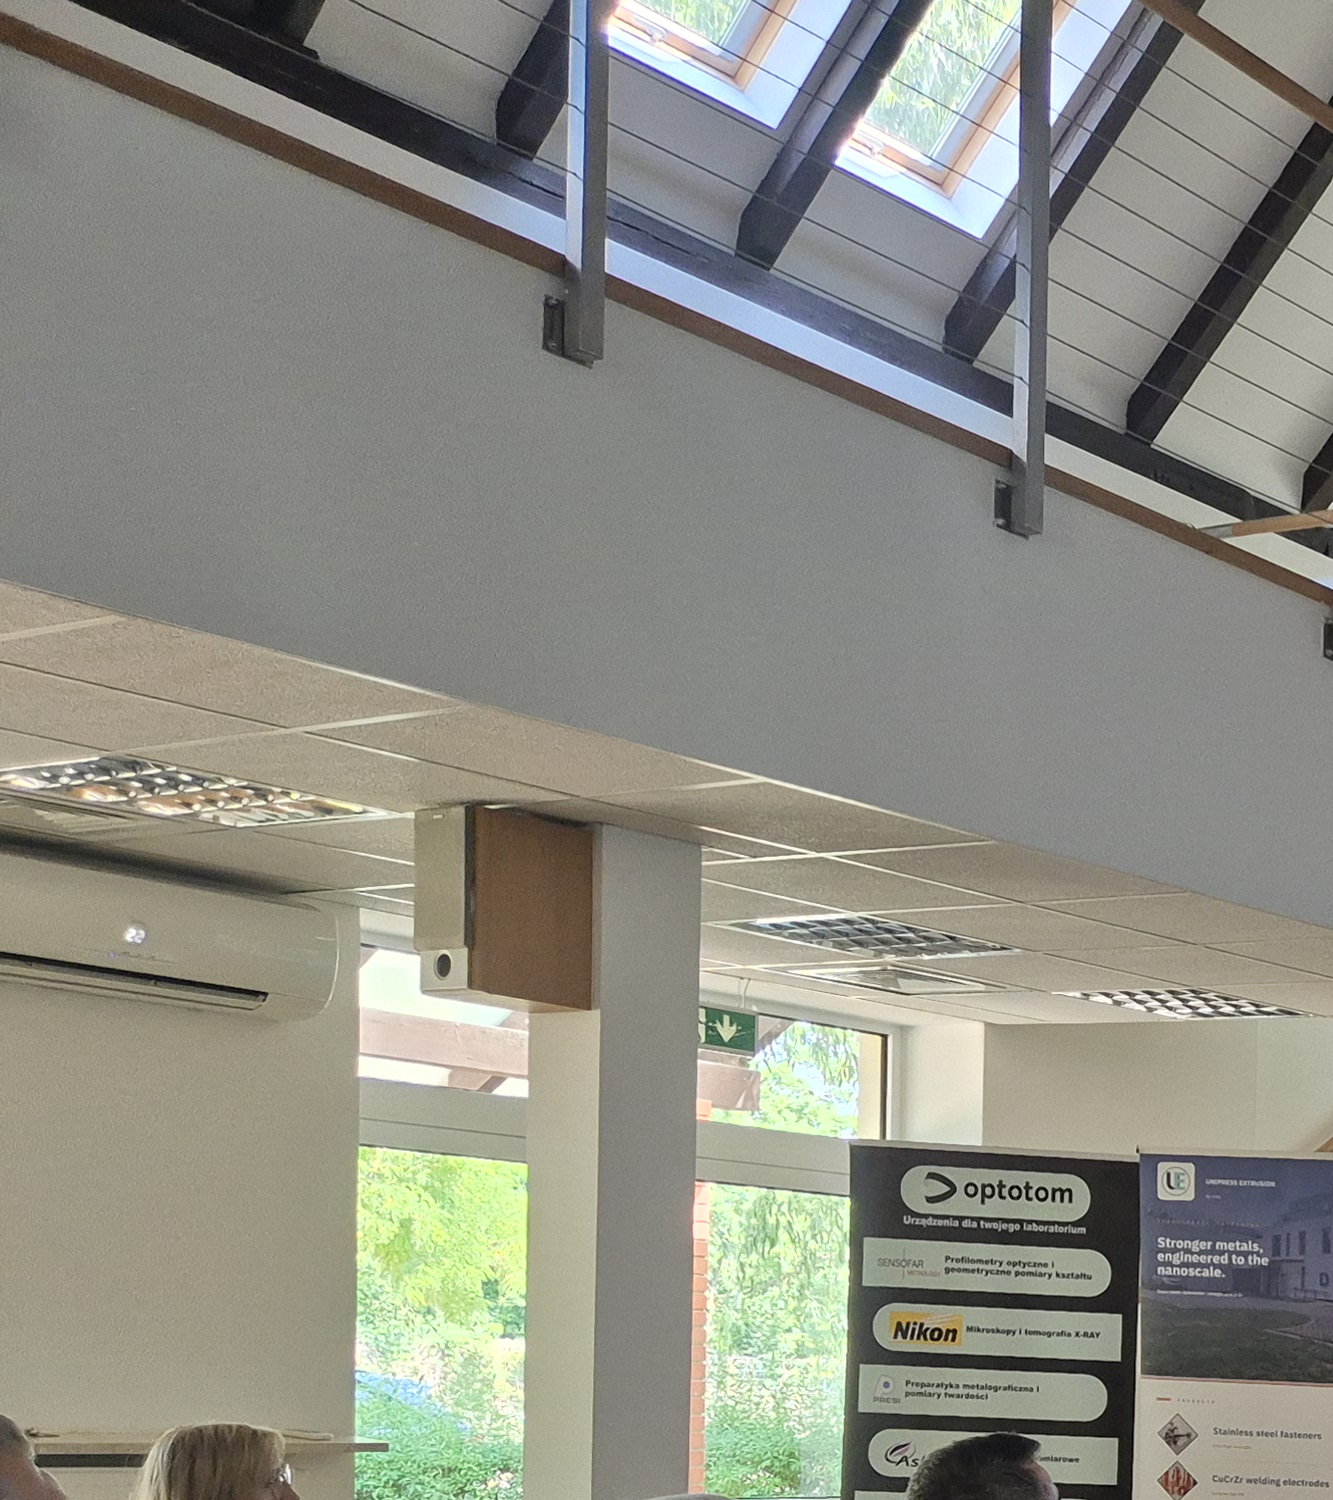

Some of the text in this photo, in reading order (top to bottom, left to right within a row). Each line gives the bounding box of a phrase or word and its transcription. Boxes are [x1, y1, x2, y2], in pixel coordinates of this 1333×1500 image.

[963, 1179, 1074, 1206] optotom
[961, 1218, 978, 1229] dla
[979, 1219, 1021, 1232] twojego
[1022, 1221, 1087, 1235] laboratorium
[1157, 1236, 1264, 1254] Stronger metals,
[876, 1257, 924, 1269] SENSOFAR
[944, 1255, 1004, 1268] Profilometry
[1006, 1259, 1049, 1270] optyczne
[1157, 1251, 1269, 1266] engineered to the
[944, 1265, 1012, 1277] geometryczne
[1014, 1268, 1053, 1280] pomiary
[1157, 1265, 1226, 1278] nanoscale.
[892, 1320, 959, 1343] Nikon
[965, 1325, 1017, 1336] Mikroskopy
[1024, 1328, 1072, 1339] tomografia
[1074, 1330, 1101, 1340] X-RAY
[904, 1379, 960, 1391] Preparatyka
[962, 1382, 1035, 1394] metalograficzna
[904, 1390, 989, 1401] pomiary twardości
[1213, 1427, 1322, 1440] Stainless steel fasteners
[1212, 1475, 1330, 1488] CuCrZr welding electrodes
